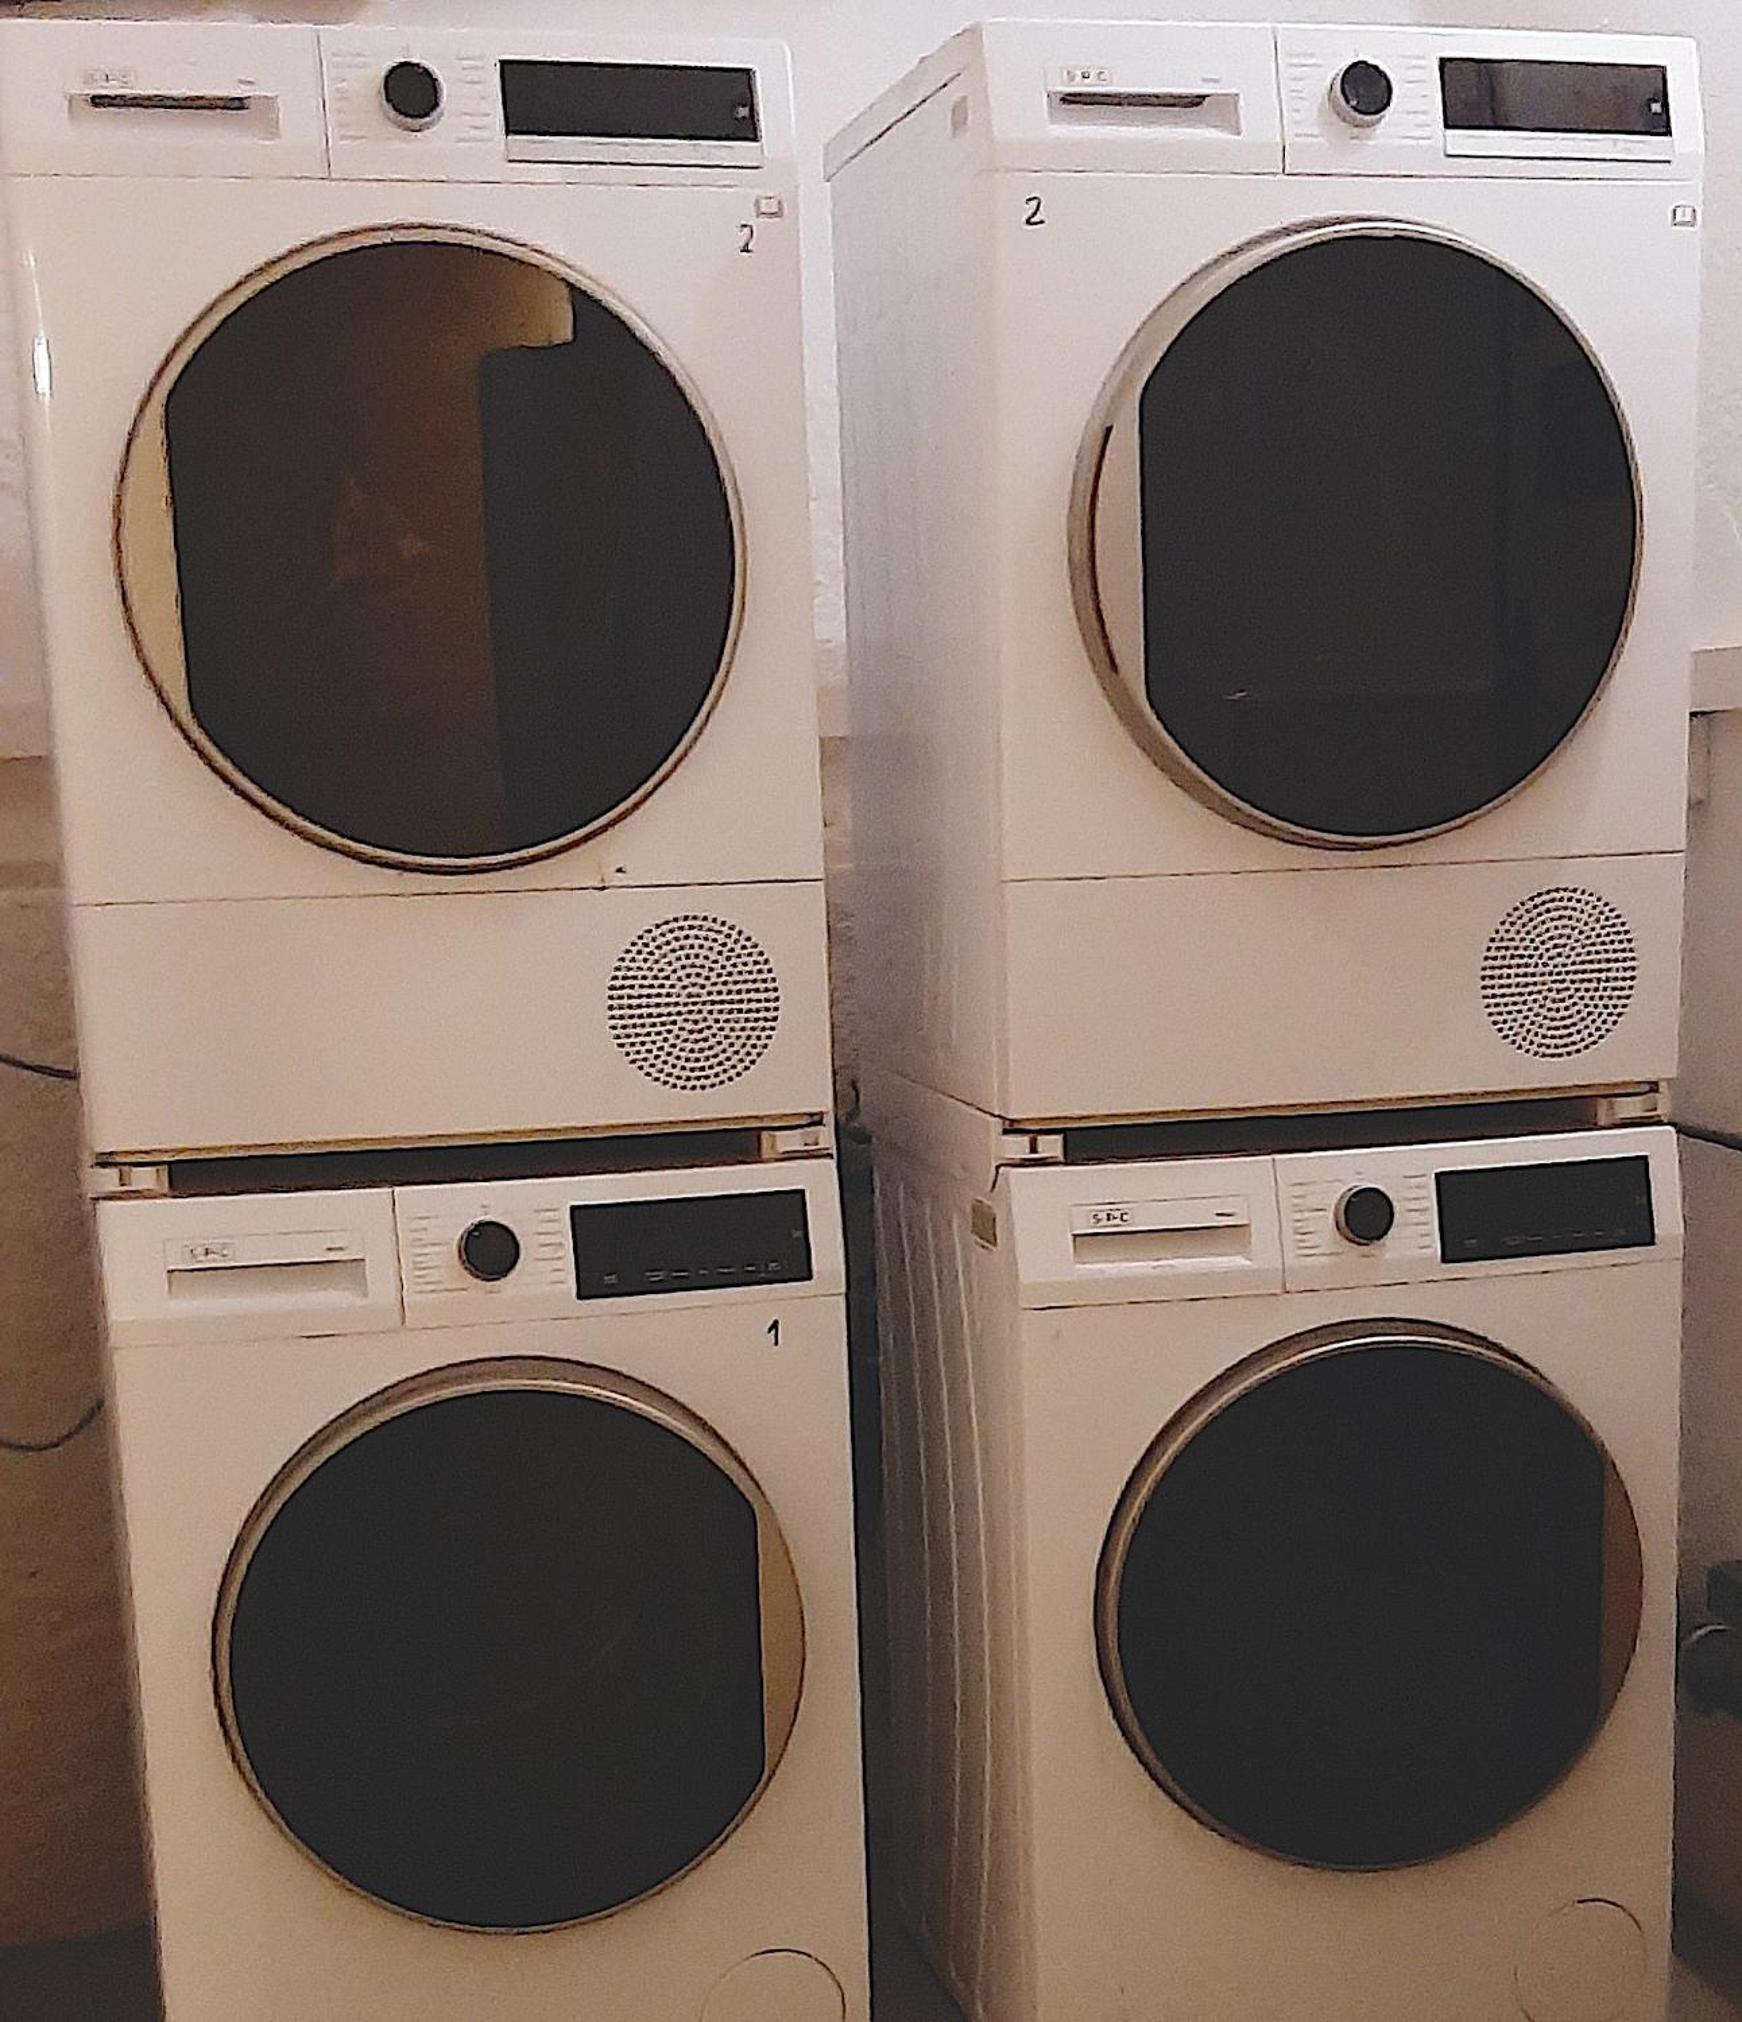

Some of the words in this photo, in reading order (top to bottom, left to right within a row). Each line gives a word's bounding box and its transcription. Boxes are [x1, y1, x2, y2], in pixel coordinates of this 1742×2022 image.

[1025, 196, 1046, 226] 2
[739, 223, 754, 253] 2
[767, 1318, 780, 1347] 1
